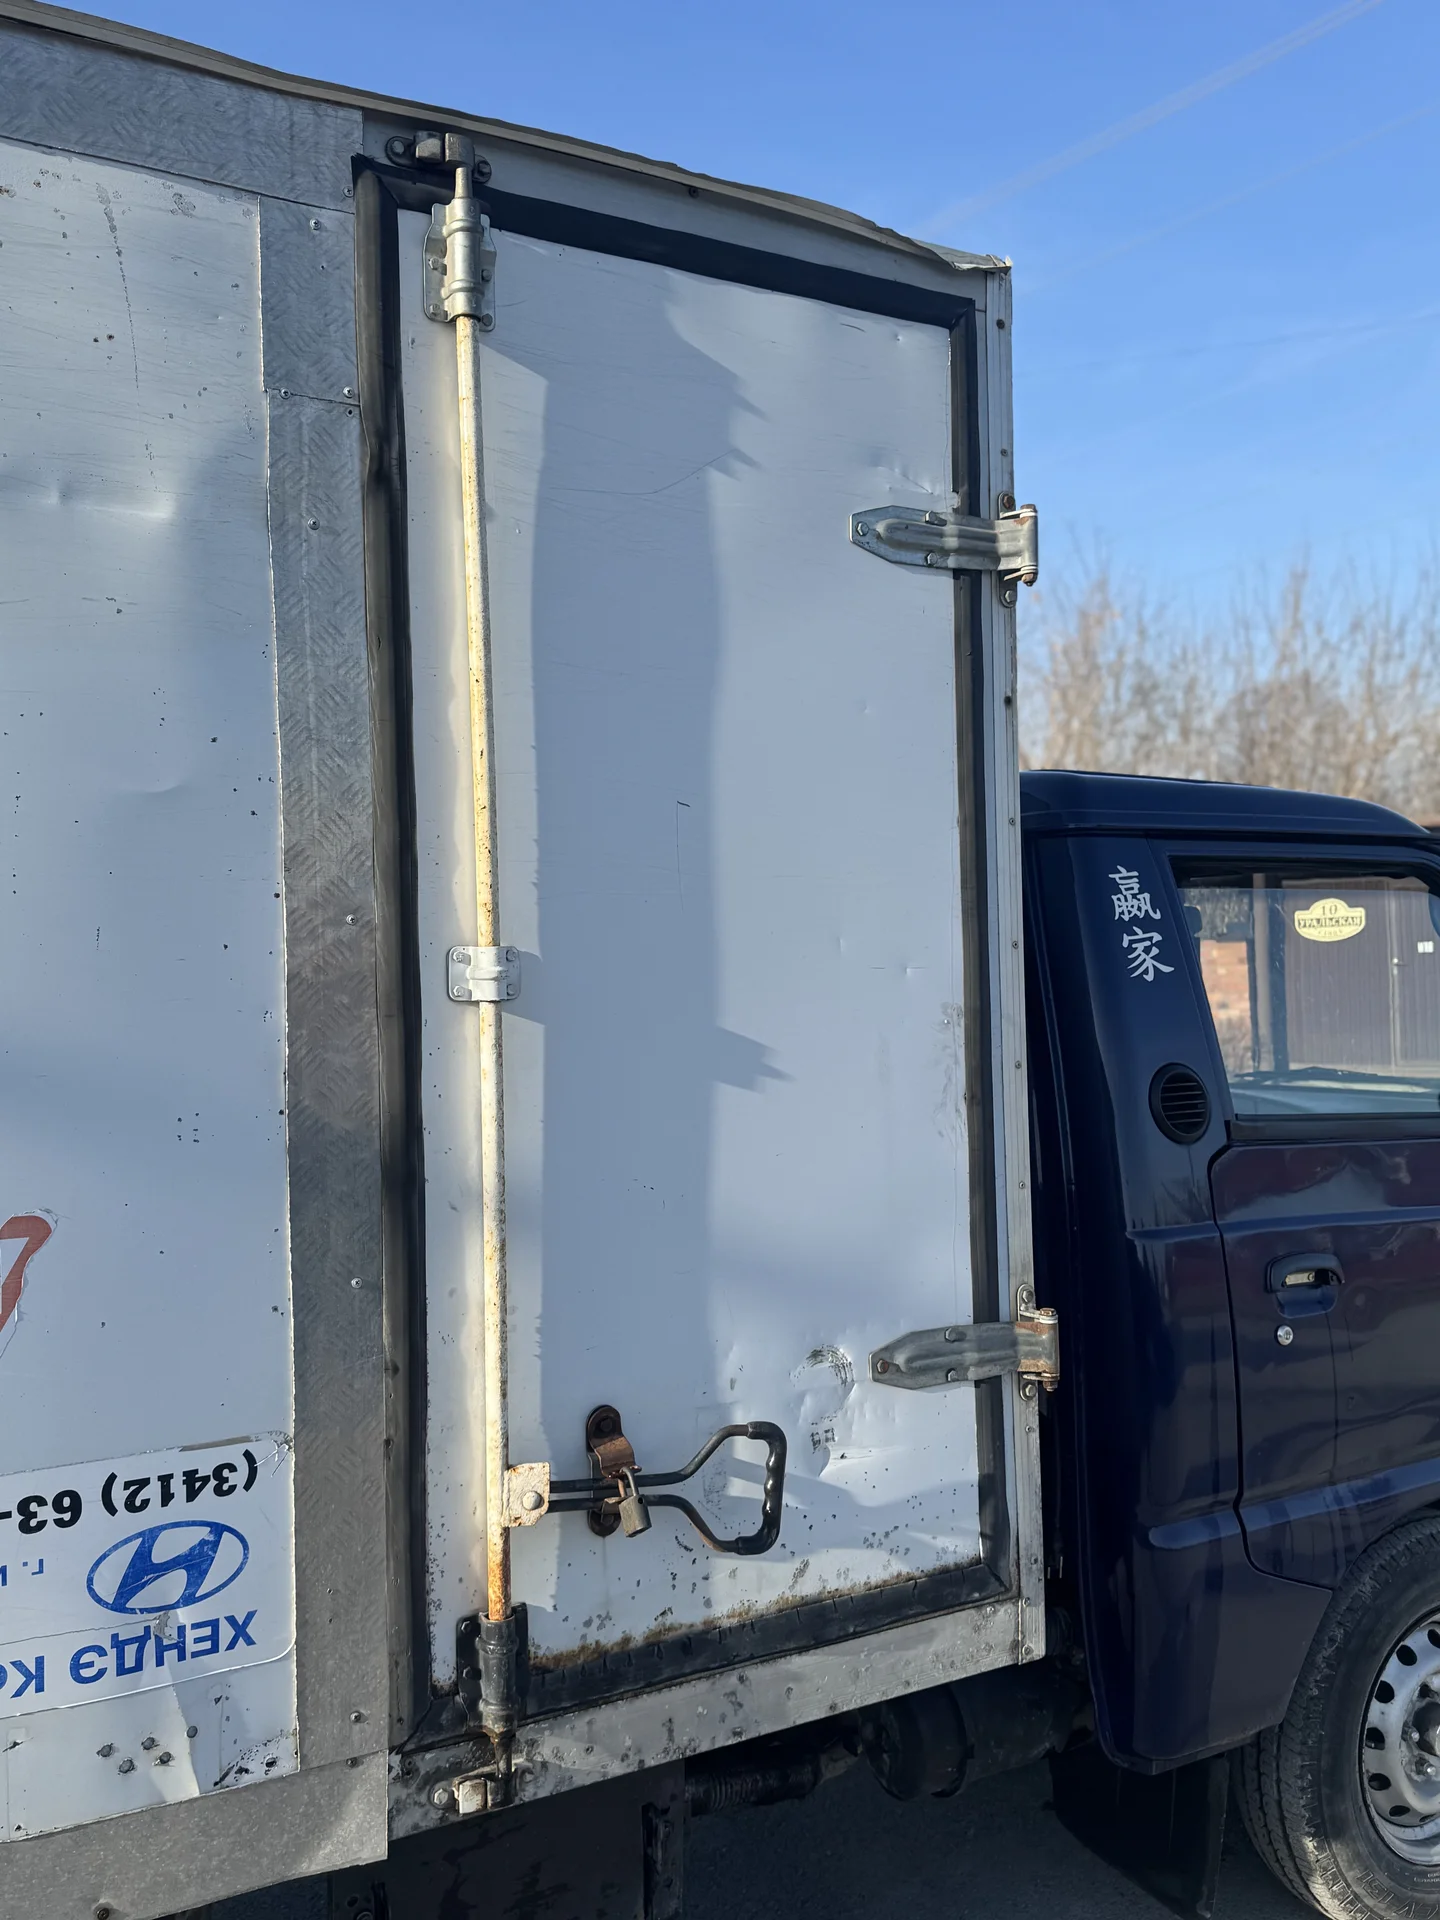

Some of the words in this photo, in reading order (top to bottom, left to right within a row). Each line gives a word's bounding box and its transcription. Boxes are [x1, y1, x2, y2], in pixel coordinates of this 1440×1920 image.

[1322, 904, 1338, 916] 10
[101, 1449, 258, 1517] (3412)
[69, 1609, 258, 1685] ХЕНДЭ
[0, 1655, 45, 1699] К
